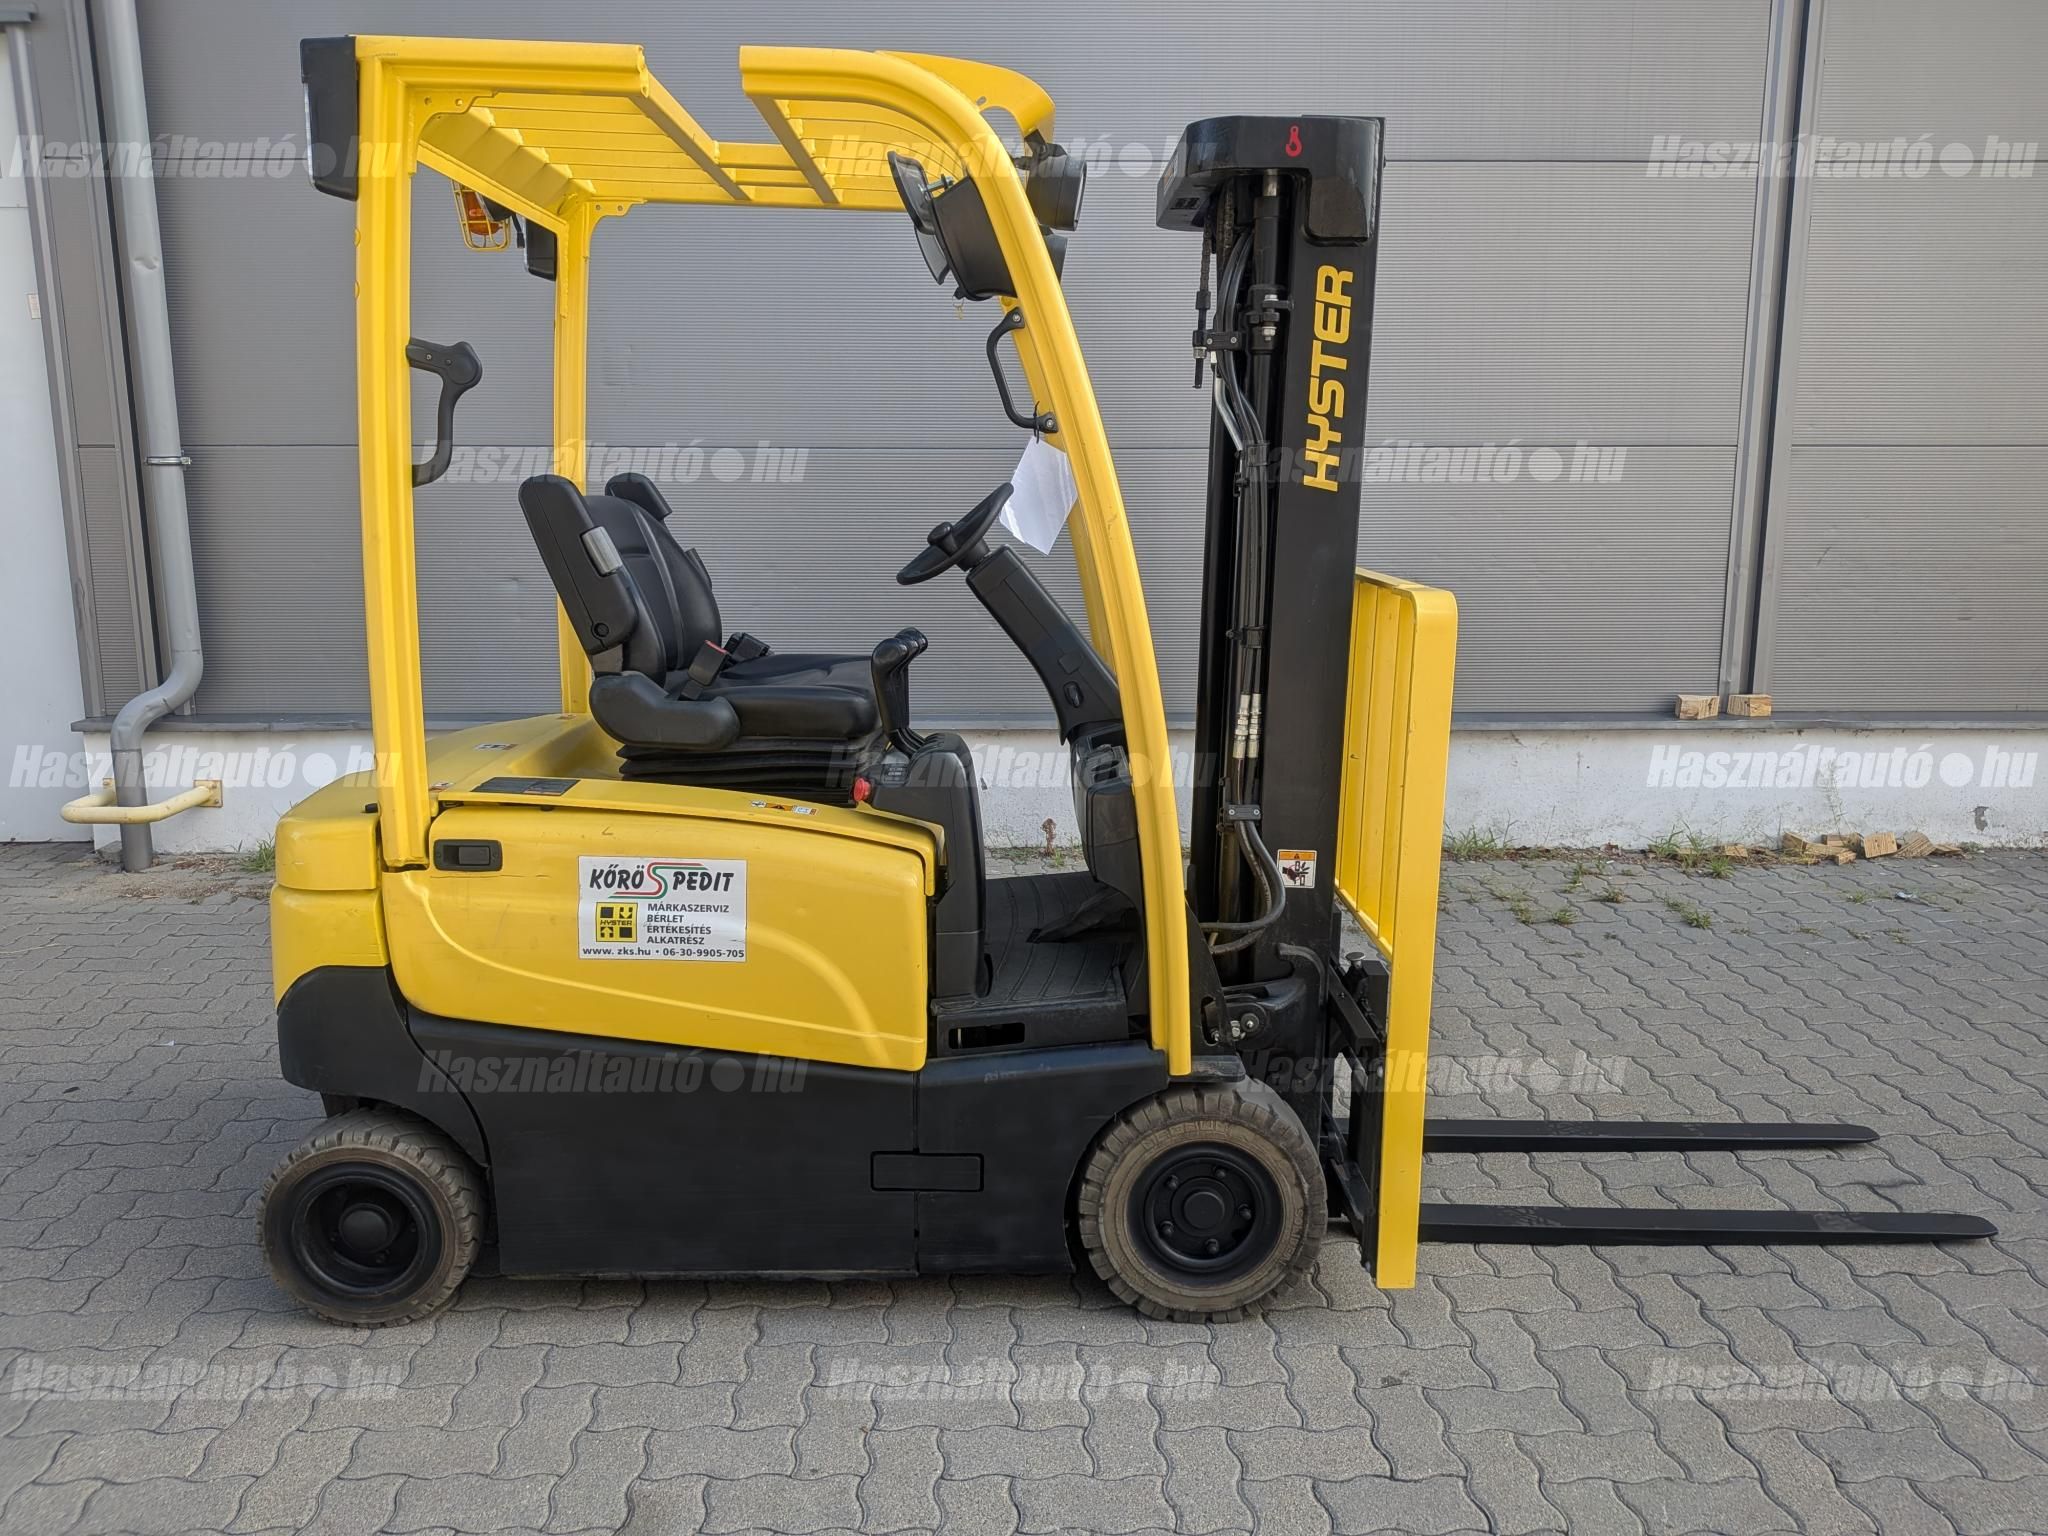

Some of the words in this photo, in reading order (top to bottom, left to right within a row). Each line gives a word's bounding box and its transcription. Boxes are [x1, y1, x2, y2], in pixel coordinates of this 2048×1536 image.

[1303, 265, 1354, 492] HYSTER
[647, 901, 730, 913] MÁRKASZERVIZ
[600, 919, 632, 927] HYSTER
[646, 912, 685, 923] BÉRLET
[647, 923, 712, 934] ÉRTÉKESÍTÉS
[646, 935, 705, 945] ALKATRÉSZ
[663, 948, 745, 957] 06-30-9905-705
